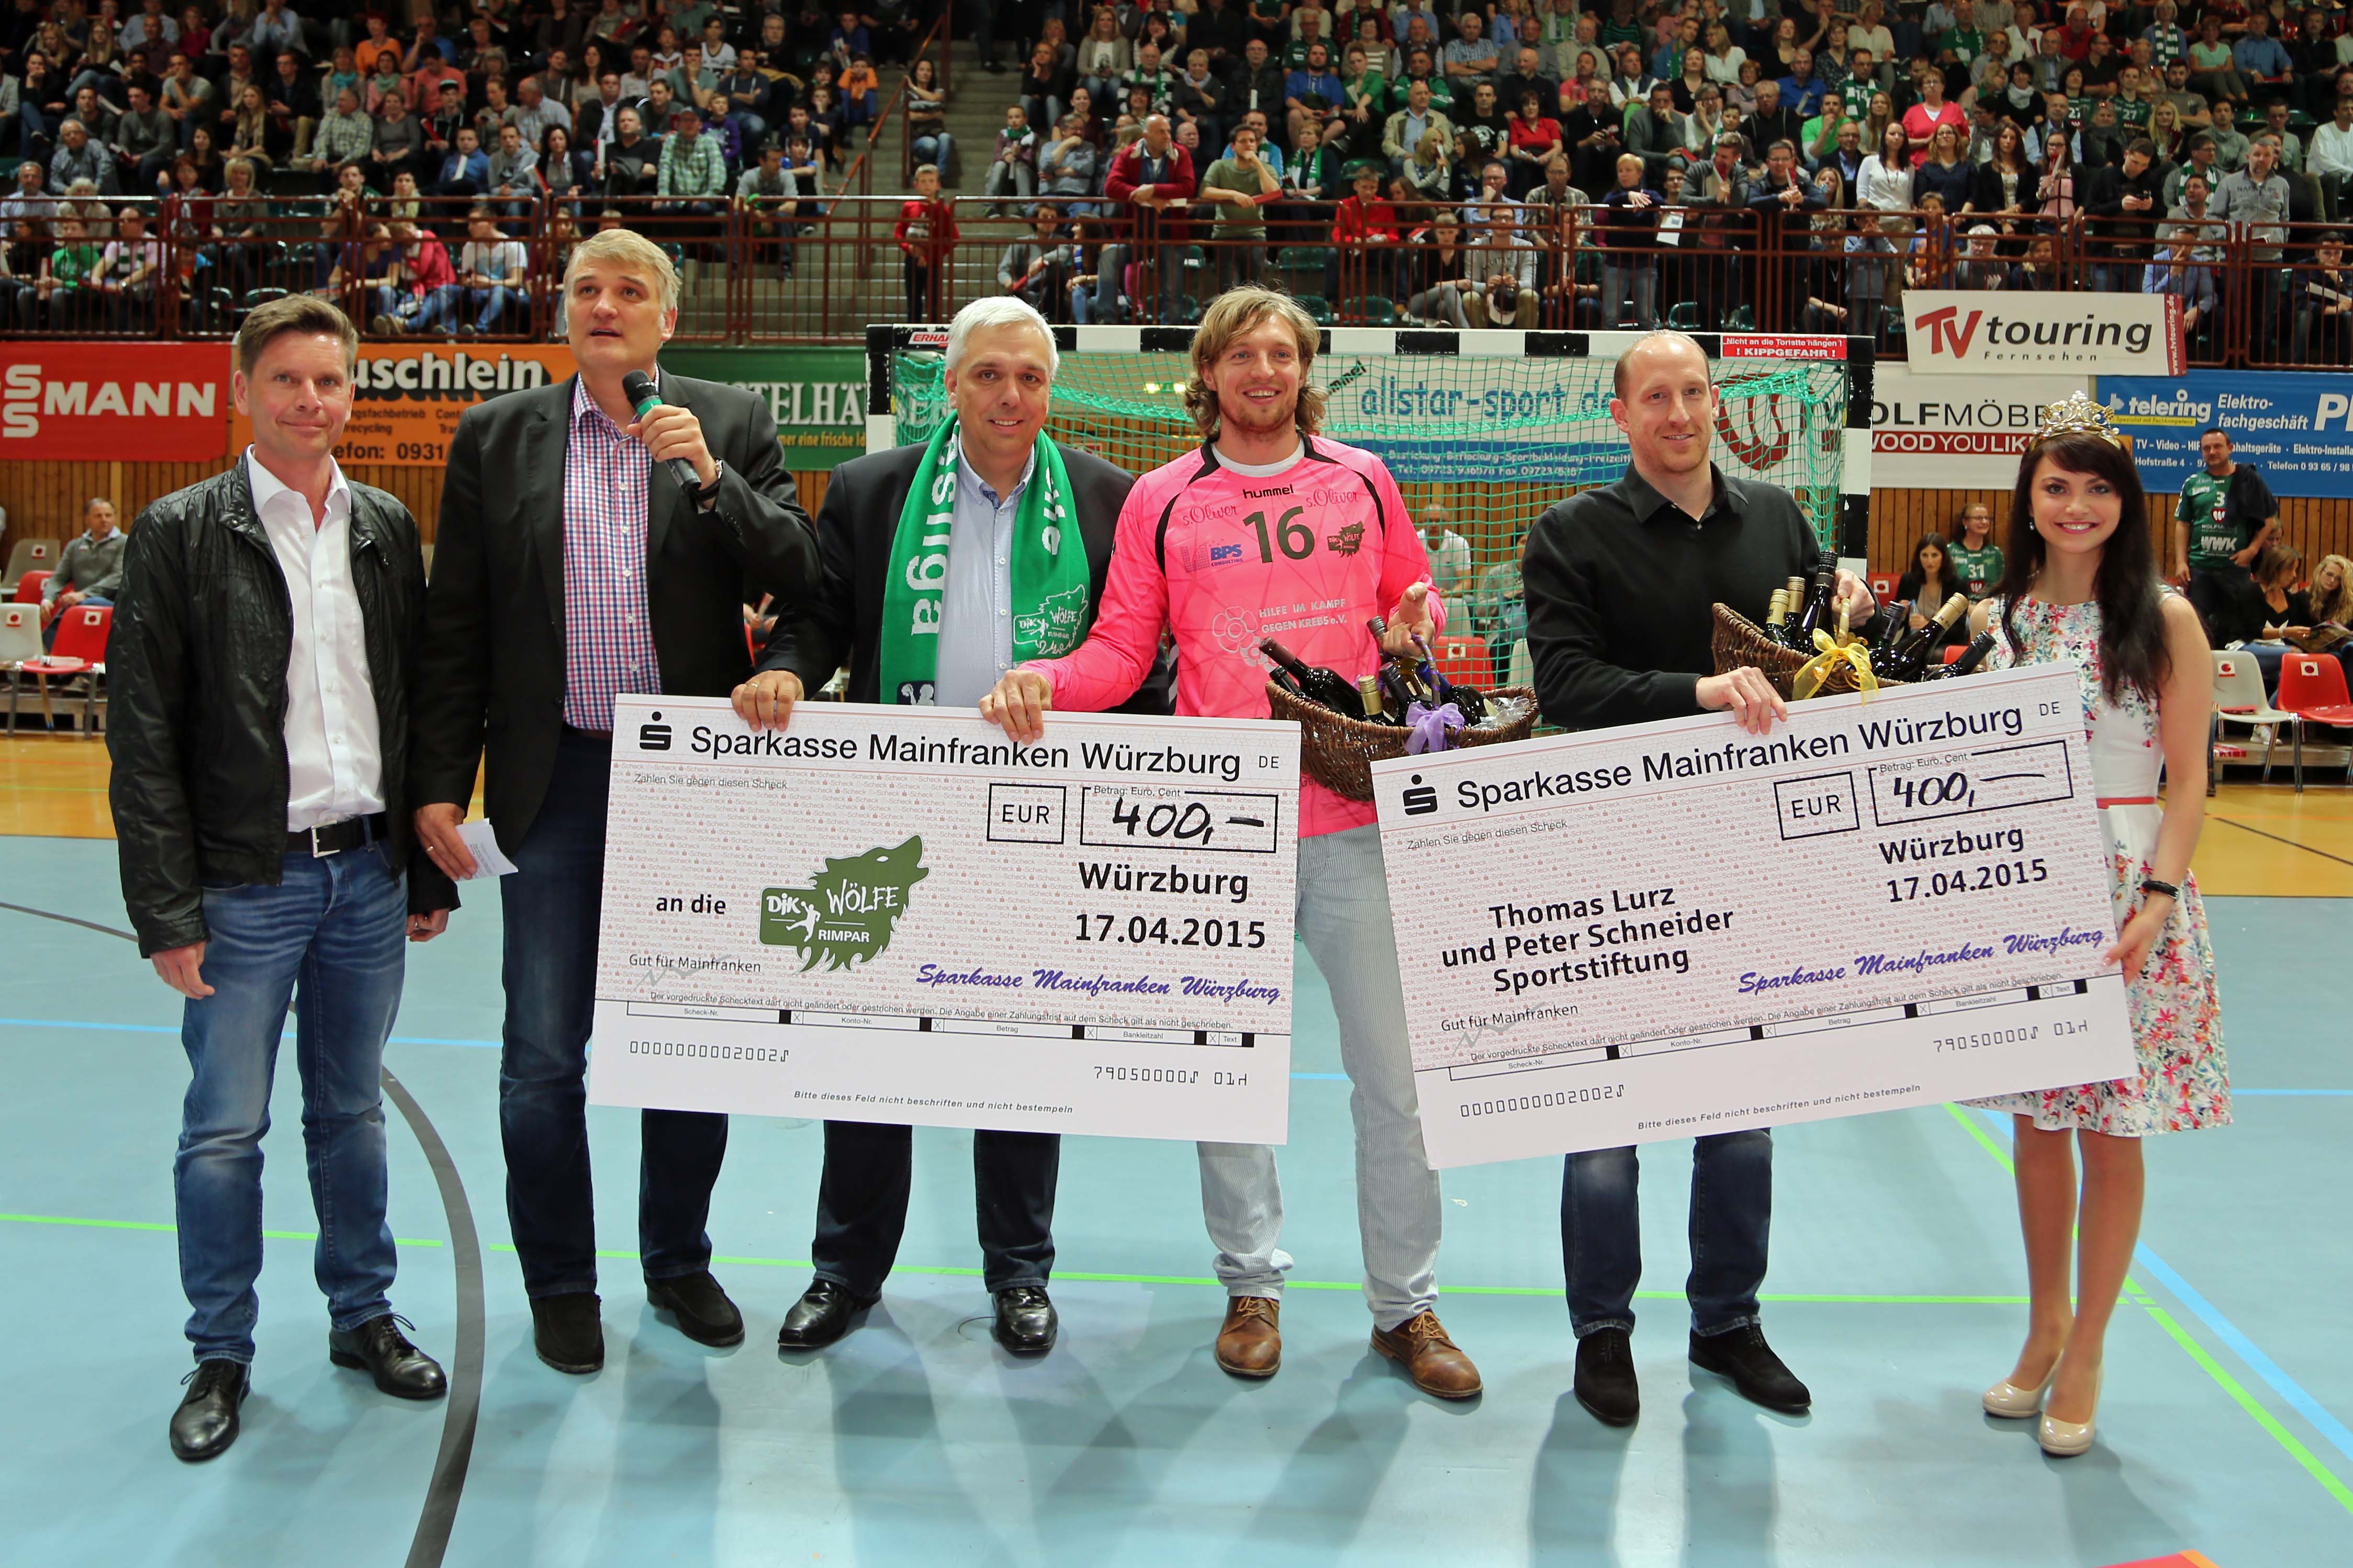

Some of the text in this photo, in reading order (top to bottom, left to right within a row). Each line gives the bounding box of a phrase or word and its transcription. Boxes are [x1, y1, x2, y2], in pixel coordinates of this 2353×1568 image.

[2122, 109, 2137, 120] 27
[1915, 306, 2152, 359] TV touring
[2167, 294, 2178, 376] www.tvtouring.de
[1744, 348, 1828, 357] KIPPGEFAHR
[1984, 351, 2098, 362] Fernsehen
[2129, 389, 2212, 423] telering
[2217, 393, 2273, 410] Elektro-
[2217, 413, 2309, 432] fachgeschäft
[798, 432, 819, 447] eine
[821, 431, 854, 447] frische
[2135, 438, 2148, 449] TV
[2156, 440, 2180, 451] Video
[2135, 456, 2178, 467] Hofstraße
[2179, 458, 2185, 467] 4
[2267, 461, 2298, 471] Telefon
[2309, 461, 2319, 472] 93
[2321, 462, 2332, 472] 65
[1243, 484, 1294, 499] hummel
[1306, 489, 1359, 508] s.Oliver
[1182, 504, 1238, 526] s.Oliver
[1243, 506, 1315, 563] 16
[2201, 536, 2237, 551] WWK
[1211, 544, 1243, 561] BPS
[1211, 558, 1244, 567] CONSULTING
[1968, 564, 1985, 579] 31
[1259, 606, 1287, 618] HILFE
[1311, 599, 1346, 612] KAMPF
[1261, 614, 1348, 634] GEGEN KREBS e.V.
[691, 723, 1280, 781] Sparkasse Mainfranken Würzburg DE
[1458, 702, 2061, 809] Sparkasse Mainfranken Würzburg DE
[635, 774, 787, 789] Zahlen Sie gegen diesen Scheck
[1094, 785, 1127, 797] Betrag:
[1131, 787, 1154, 796] Euro,
[1002, 805, 1050, 824] EUR
[1792, 794, 1842, 819] EUR
[1879, 829, 2023, 864] Würzburg
[1079, 862, 1247, 903] Würzburg
[1888, 859, 2046, 902] 17.04.2015
[657, 894, 725, 914] an die
[826, 879, 899, 917] WÖLFE
[1489, 888, 1675, 928] Thomas Lurz
[817, 929, 870, 943] RIMPAR
[1077, 915, 1264, 948] 17.04.2015
[1442, 909, 1733, 967] und Peter Schneider
[630, 955, 760, 972] Gut für Mainfranken
[1739, 927, 2102, 996] Sparkasse Mainfranken Würzburg
[1494, 950, 1688, 995] Sportstiftung
[916, 964, 1280, 1005] Sparkasse Mainfranken Würzburg
[1442, 1006, 1577, 1031] Gut für Mainfranken
[996, 1024, 1019, 1034] Betrag
[1123, 1031, 1164, 1041] Bankleitzahl
[907, 1098, 962, 1107] beschriften
[1017, 1104, 1072, 1113] bestempeln
